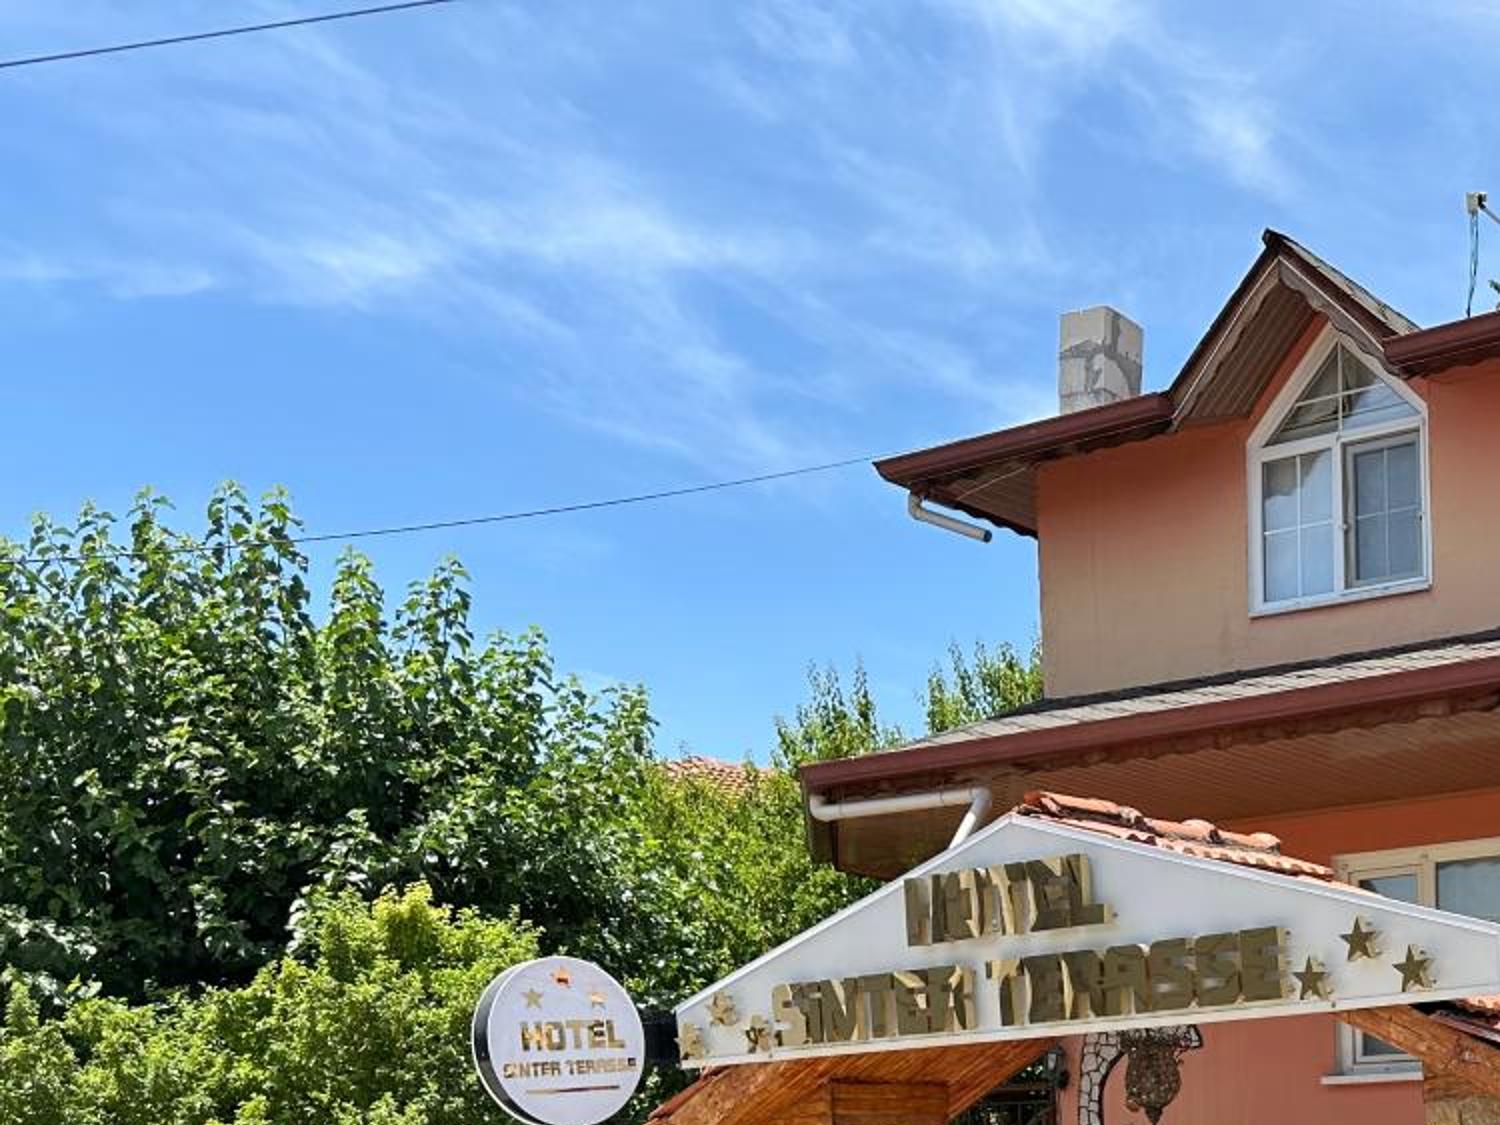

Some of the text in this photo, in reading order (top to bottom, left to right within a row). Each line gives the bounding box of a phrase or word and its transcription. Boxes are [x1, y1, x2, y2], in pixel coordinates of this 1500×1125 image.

[903, 854, 1108, 947] HOTEL
[772, 926, 1288, 1048] SINTER TERASSE
[520, 1019, 625, 1051] HOTEL
[503, 1061, 561, 1079] SINTER
